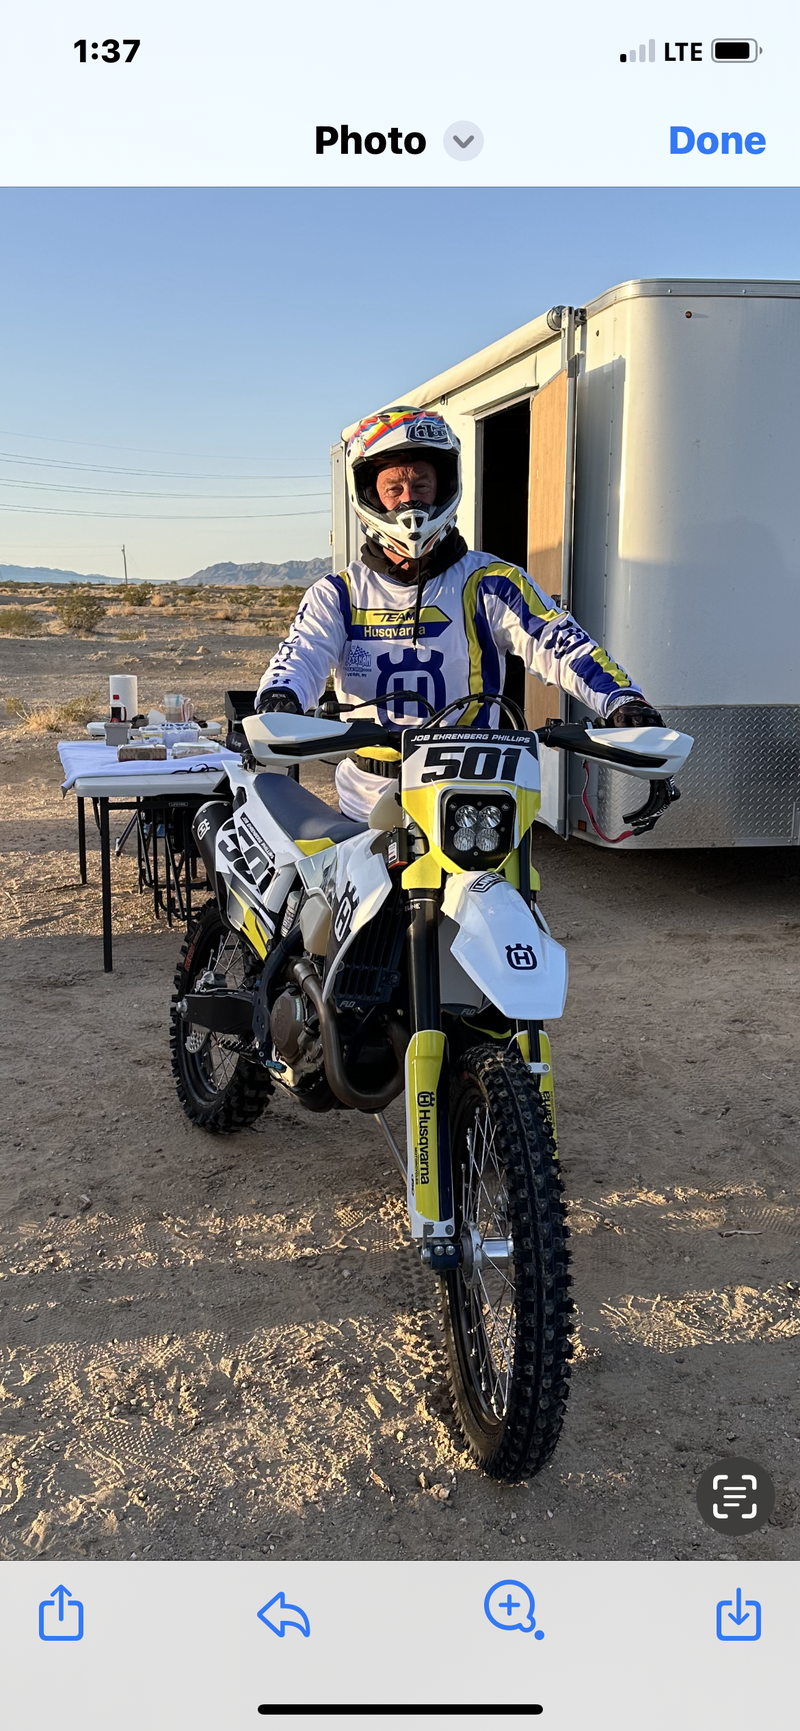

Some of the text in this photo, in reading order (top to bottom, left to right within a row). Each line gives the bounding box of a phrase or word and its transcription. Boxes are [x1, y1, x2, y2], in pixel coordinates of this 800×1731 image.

[373, 612, 415, 622] TEAM
[364, 626, 426, 638] Husqvara
[411, 733, 531, 743] JOB EHRENBERG PHILLIPS
[421, 746, 522, 784] 501
[218, 825, 276, 896] 501
[339, 1000, 356, 1008] FLO
[418, 1109, 431, 1185] Husqvarna
